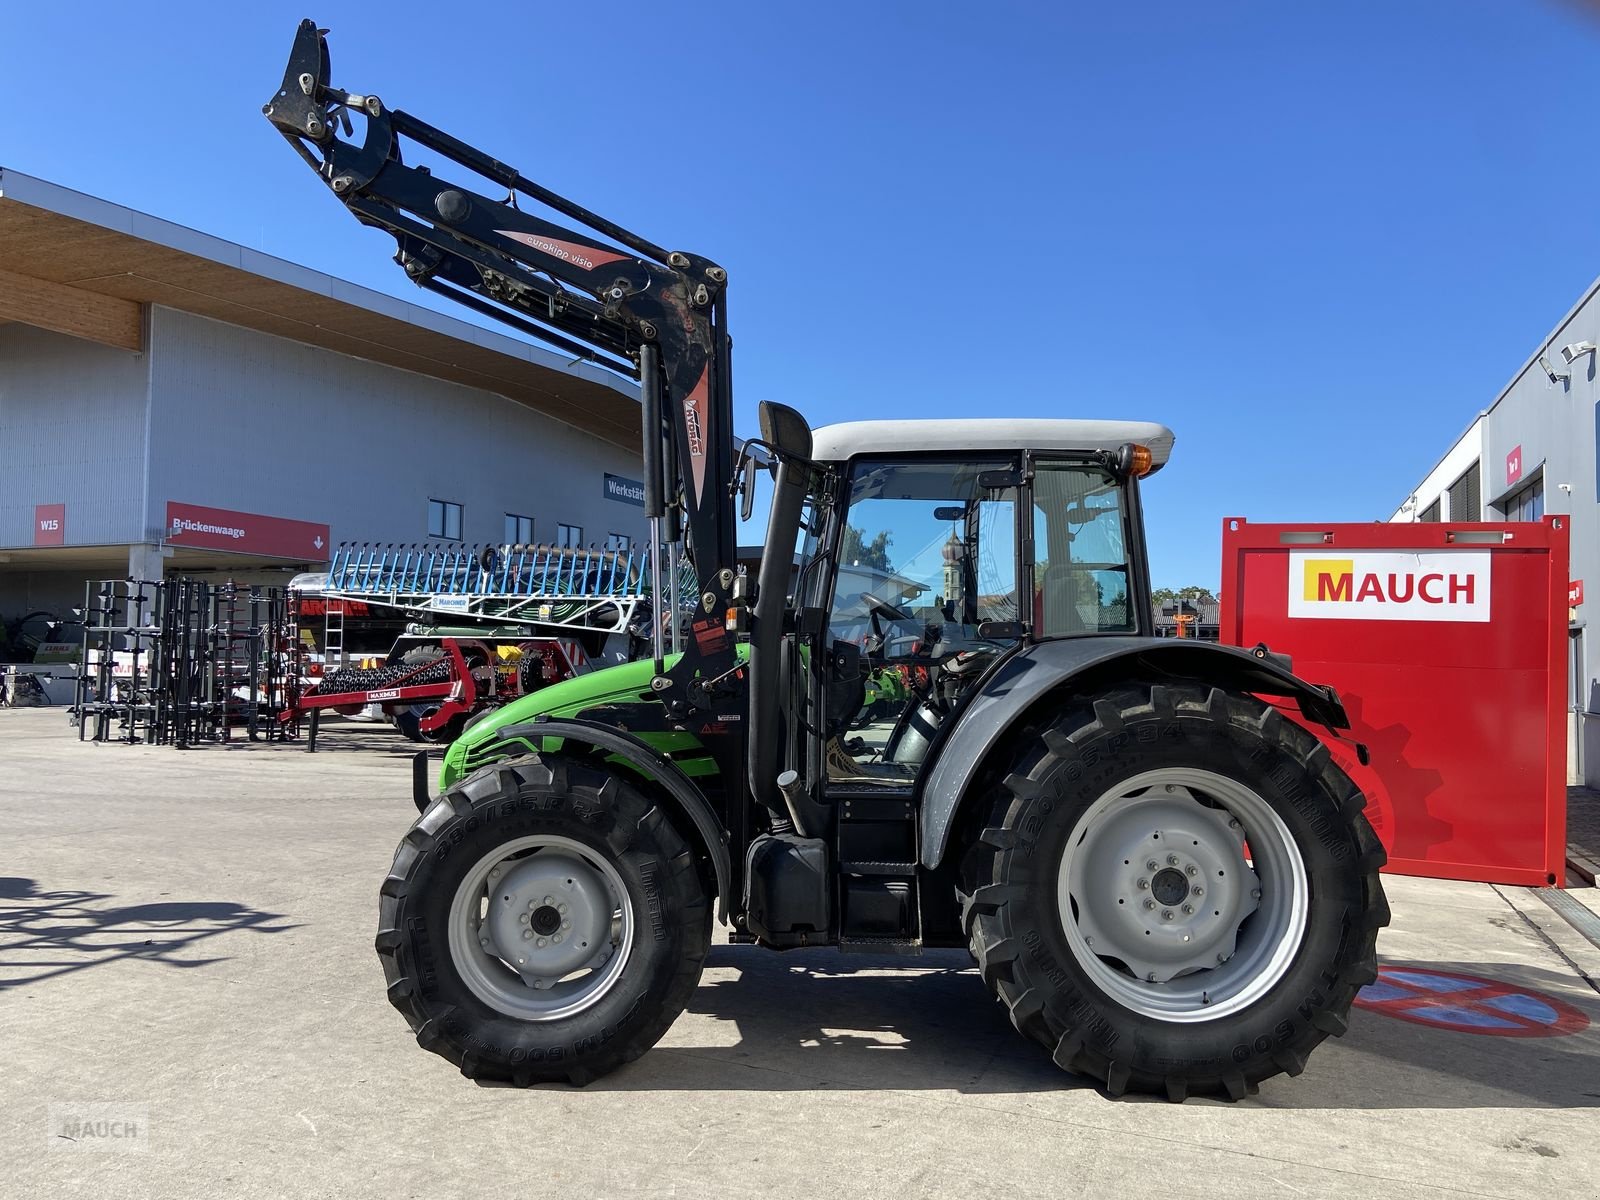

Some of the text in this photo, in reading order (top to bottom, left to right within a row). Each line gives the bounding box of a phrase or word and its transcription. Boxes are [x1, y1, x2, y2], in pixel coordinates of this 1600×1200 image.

[527, 236, 593, 268] eurokipp visio
[685, 409, 699, 454] HYDRAC
[40, 519, 59, 531] W15
[172, 518, 246, 538] Brückenwaage
[1317, 573, 1475, 604] MAUCH
[370, 690, 397, 699] MAXIMUS
